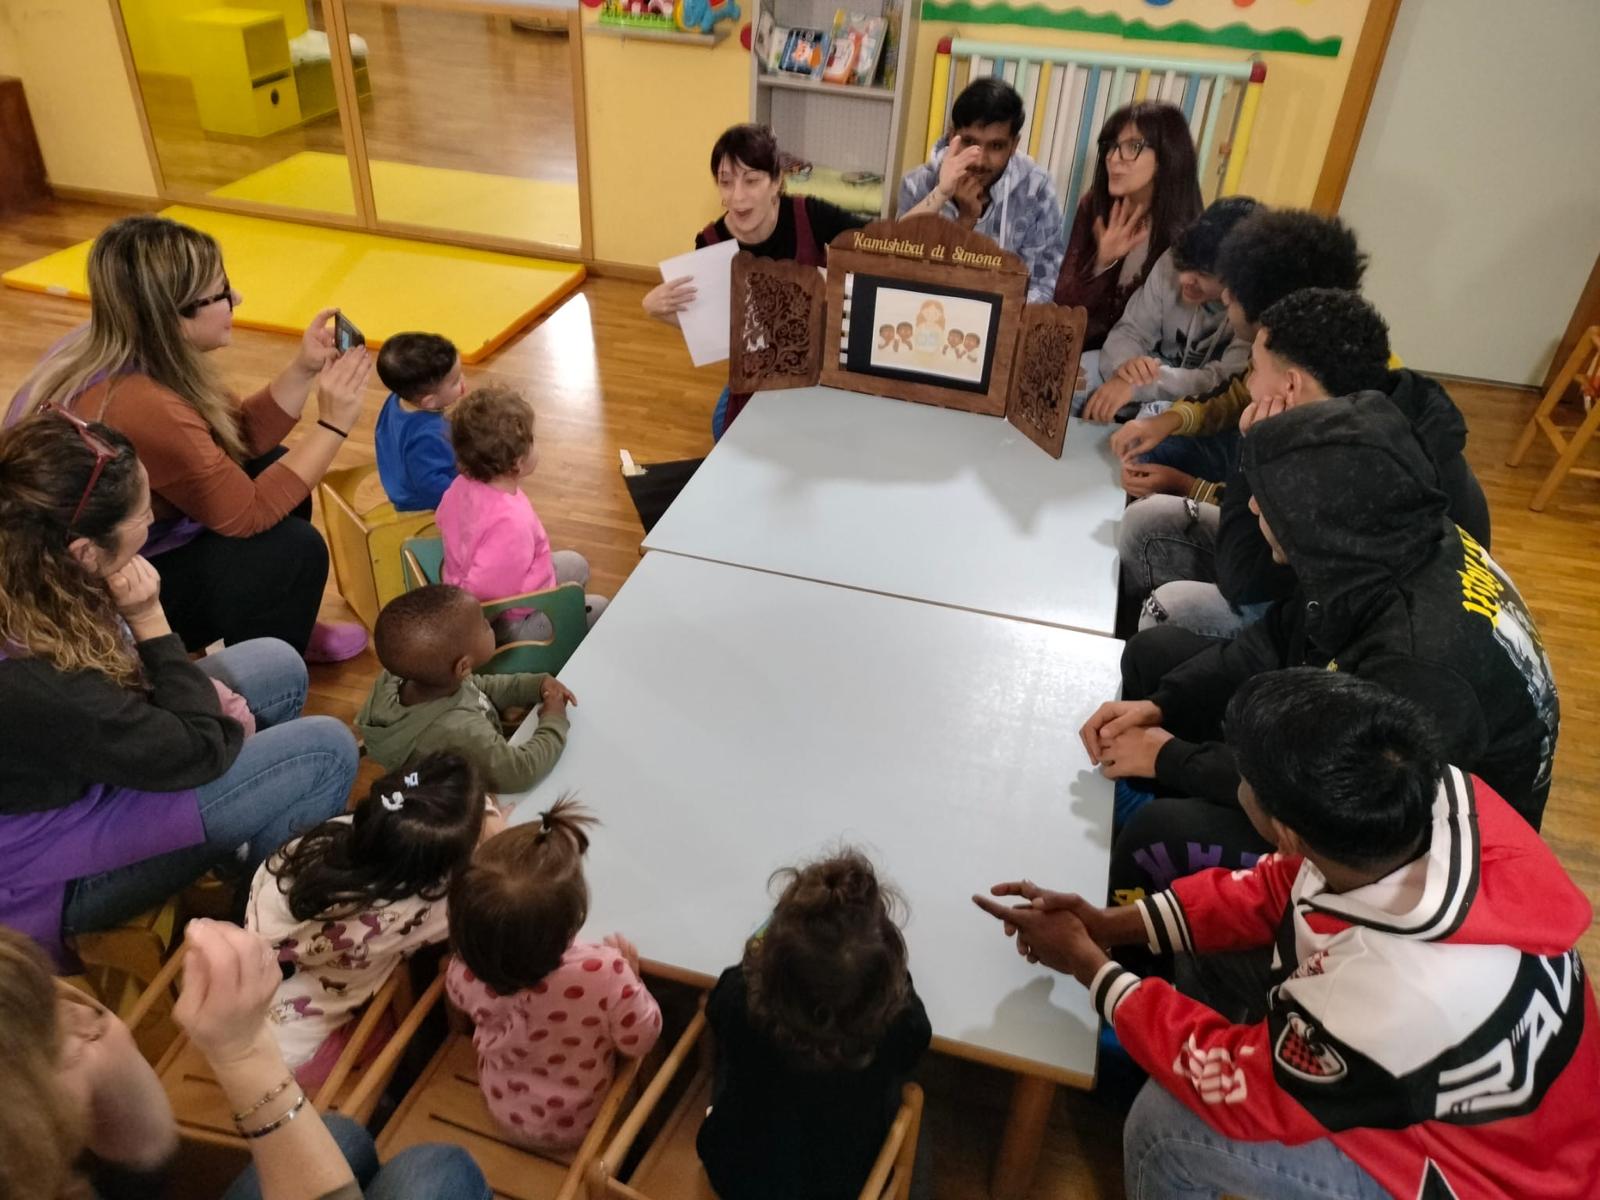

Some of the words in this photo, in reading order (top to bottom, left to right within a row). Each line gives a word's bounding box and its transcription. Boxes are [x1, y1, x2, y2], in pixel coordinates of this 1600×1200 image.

[853, 231, 925, 256] Kamishibai
[931, 244, 945, 258] di
[952, 246, 1003, 267] Simona
